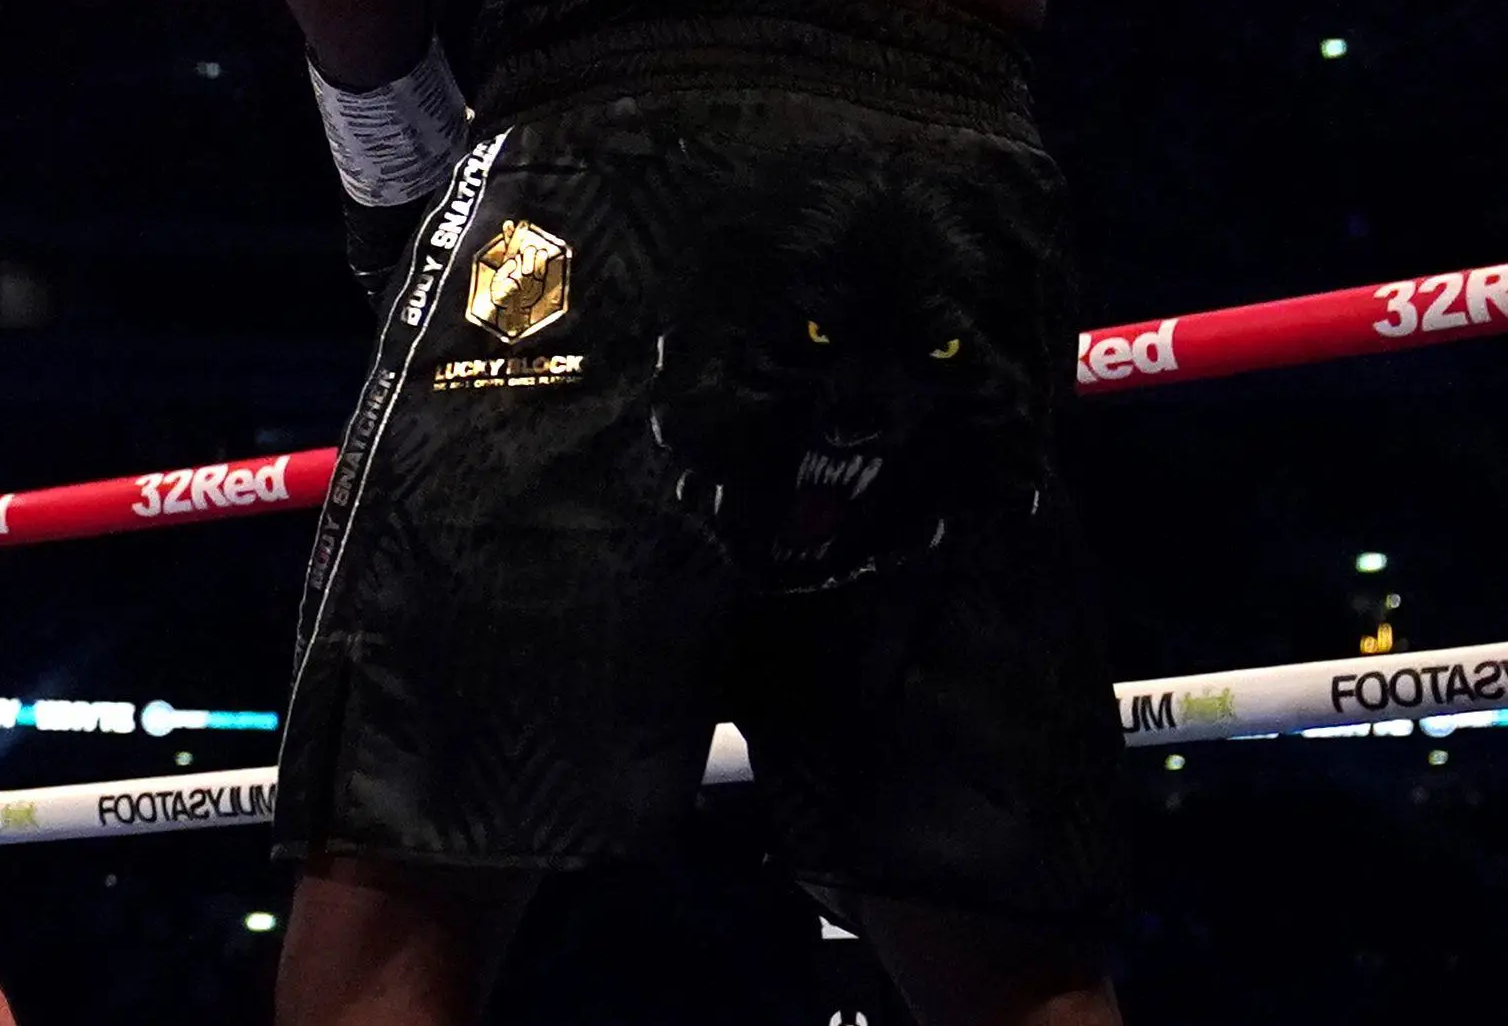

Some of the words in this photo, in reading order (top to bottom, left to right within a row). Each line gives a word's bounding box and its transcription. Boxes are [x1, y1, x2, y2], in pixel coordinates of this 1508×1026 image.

[1372, 263, 1508, 338] 32R
[434, 358, 506, 381] LUCKY
[506, 355, 585, 376] BLOCK
[131, 454, 291, 517] 32Red
[1331, 659, 1508, 713] FOOTAS
[98, 784, 277, 827] FOOTASYLUM
